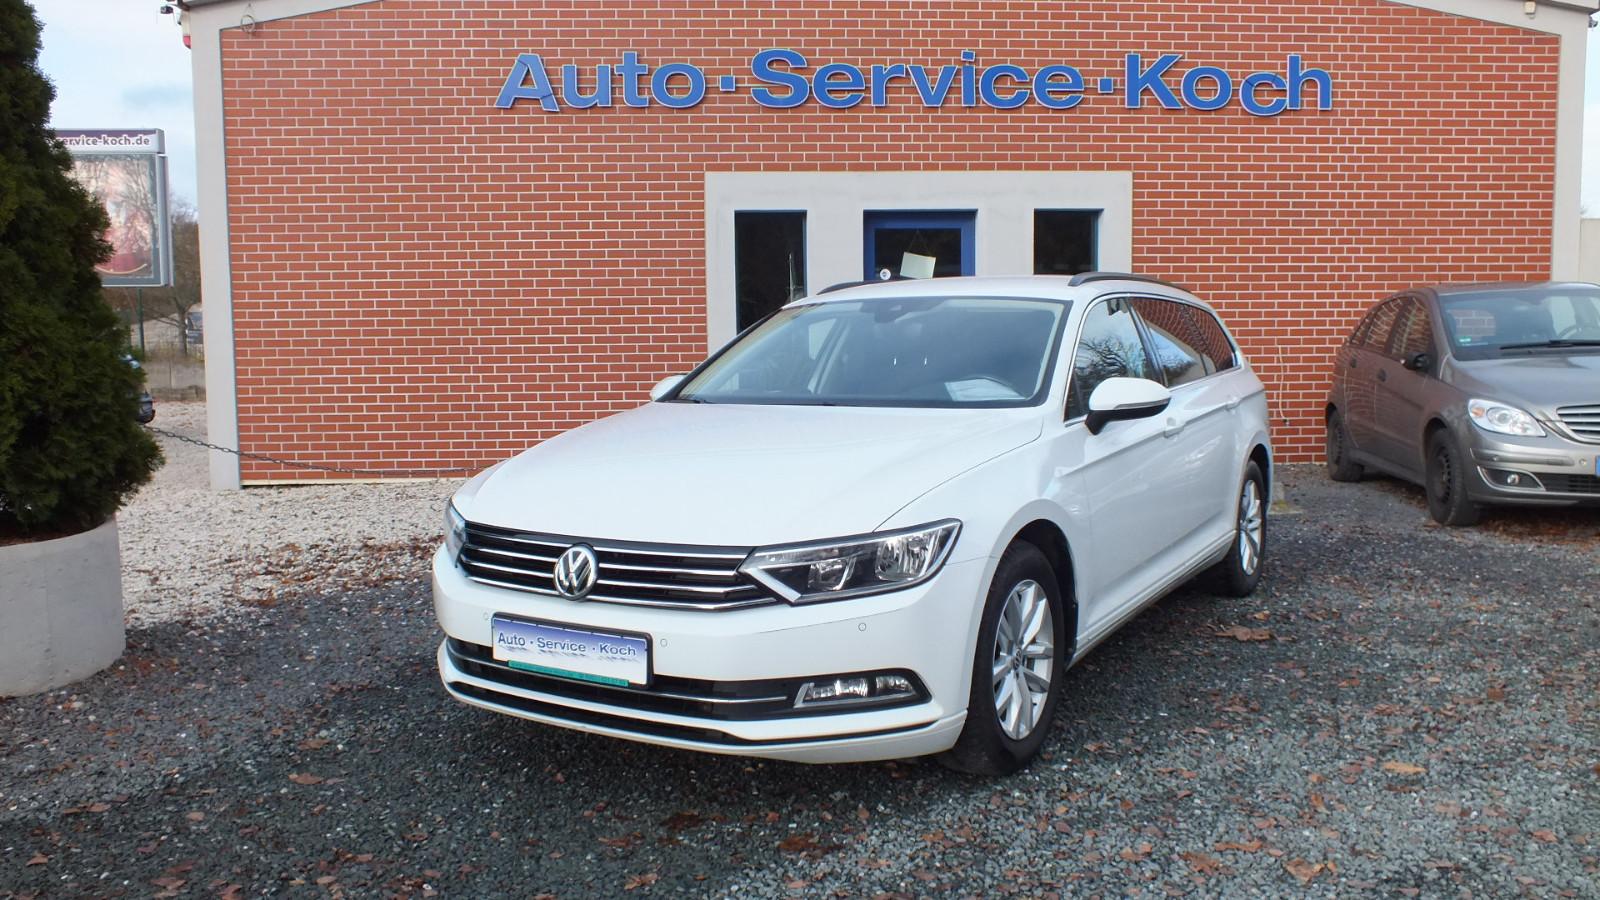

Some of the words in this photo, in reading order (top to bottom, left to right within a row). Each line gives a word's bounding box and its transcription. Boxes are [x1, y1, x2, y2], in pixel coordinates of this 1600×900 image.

[494, 51, 706, 112] Auto
[750, 48, 1085, 109] Service
[1124, 52, 1333, 117] Koch
[498, 632, 526, 647] Auto
[536, 637, 586, 652] Service
[599, 642, 636, 656] Koch
